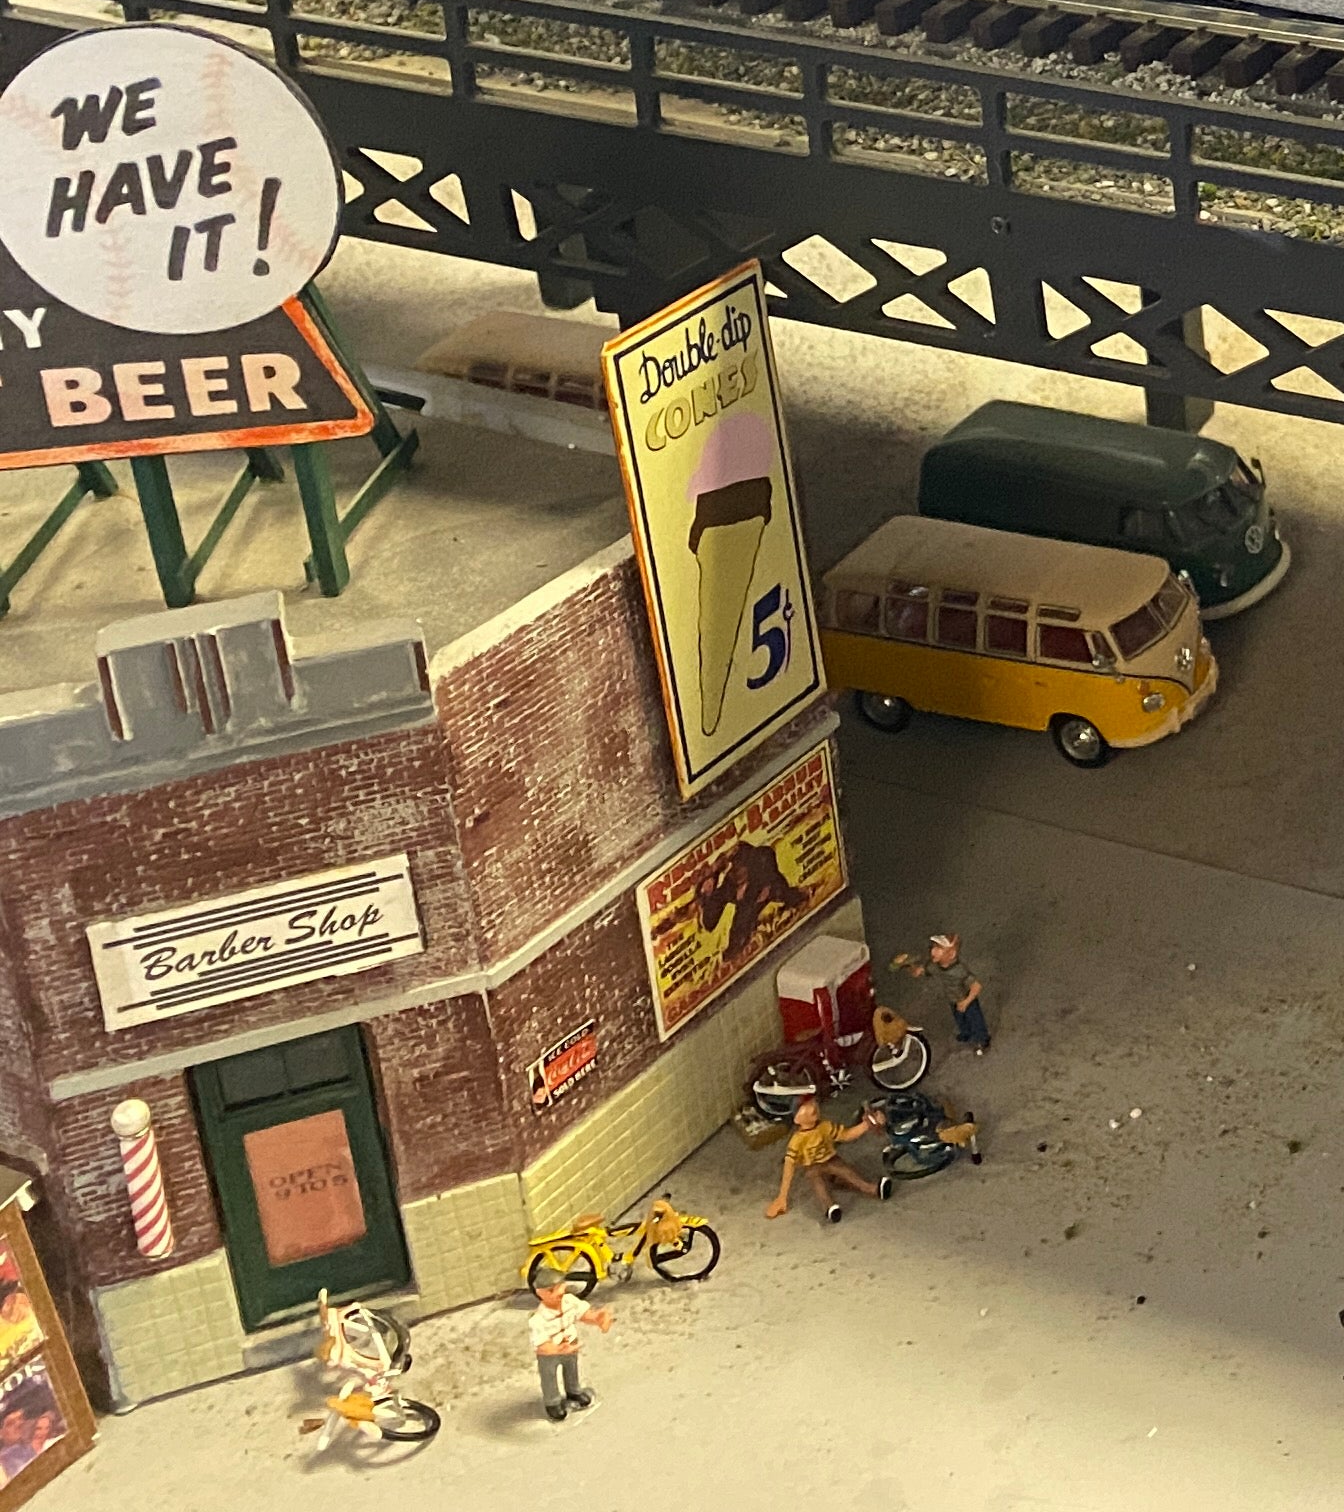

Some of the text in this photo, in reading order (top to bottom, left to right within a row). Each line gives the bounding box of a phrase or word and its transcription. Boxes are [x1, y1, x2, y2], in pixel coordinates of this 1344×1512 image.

[52, 77, 163, 152] WE
[45, 136, 238, 239] HAVE
[0, 307, 47, 350] Y
[40, 353, 309, 429] BEER
[645, 349, 758, 451] CONES
[140, 903, 384, 981] Barber Shop
